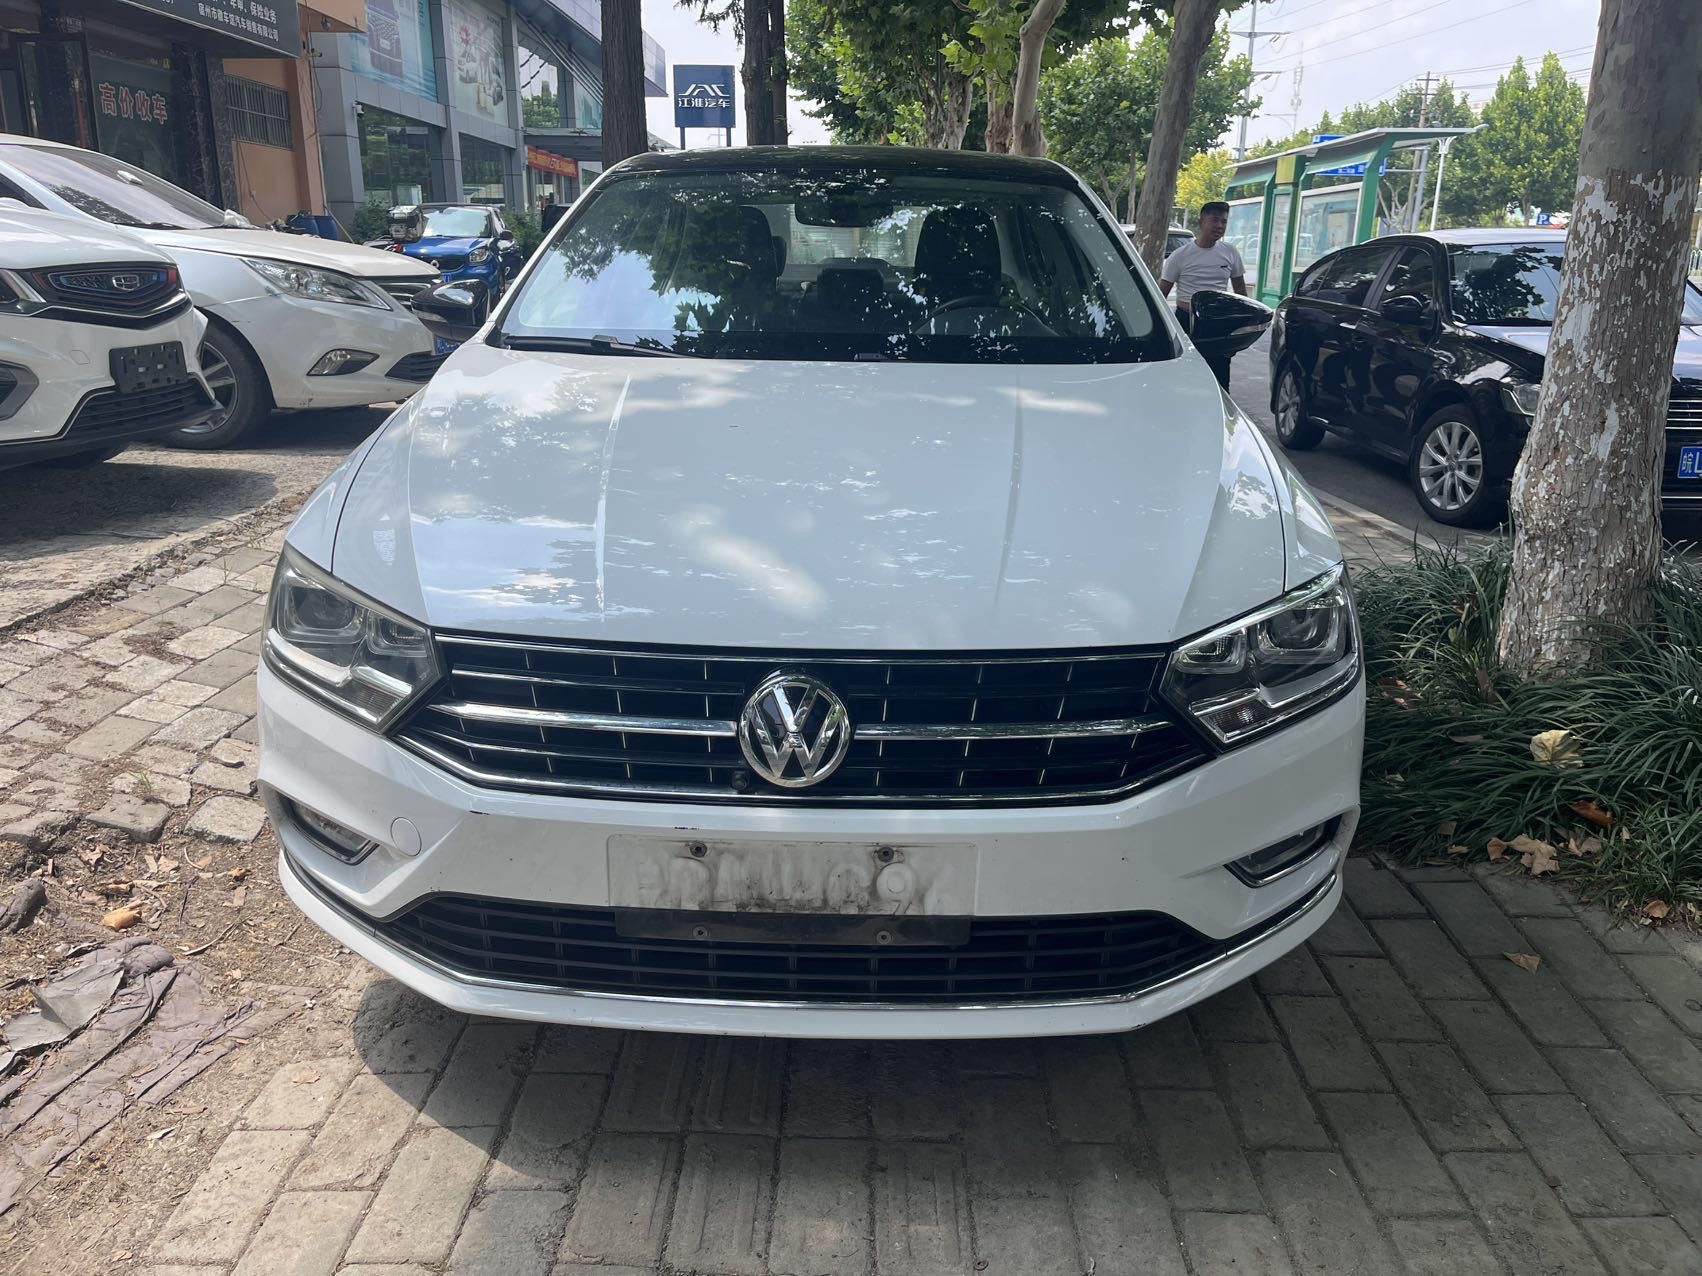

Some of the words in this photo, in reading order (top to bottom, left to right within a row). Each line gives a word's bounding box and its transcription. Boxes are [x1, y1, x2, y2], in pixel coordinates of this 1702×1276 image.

[678, 84, 730, 97] JAC
[99, 83, 167, 124] 高价收车
[678, 98, 731, 108] 江淮汽车
[1538, 214, 1548, 225] P
